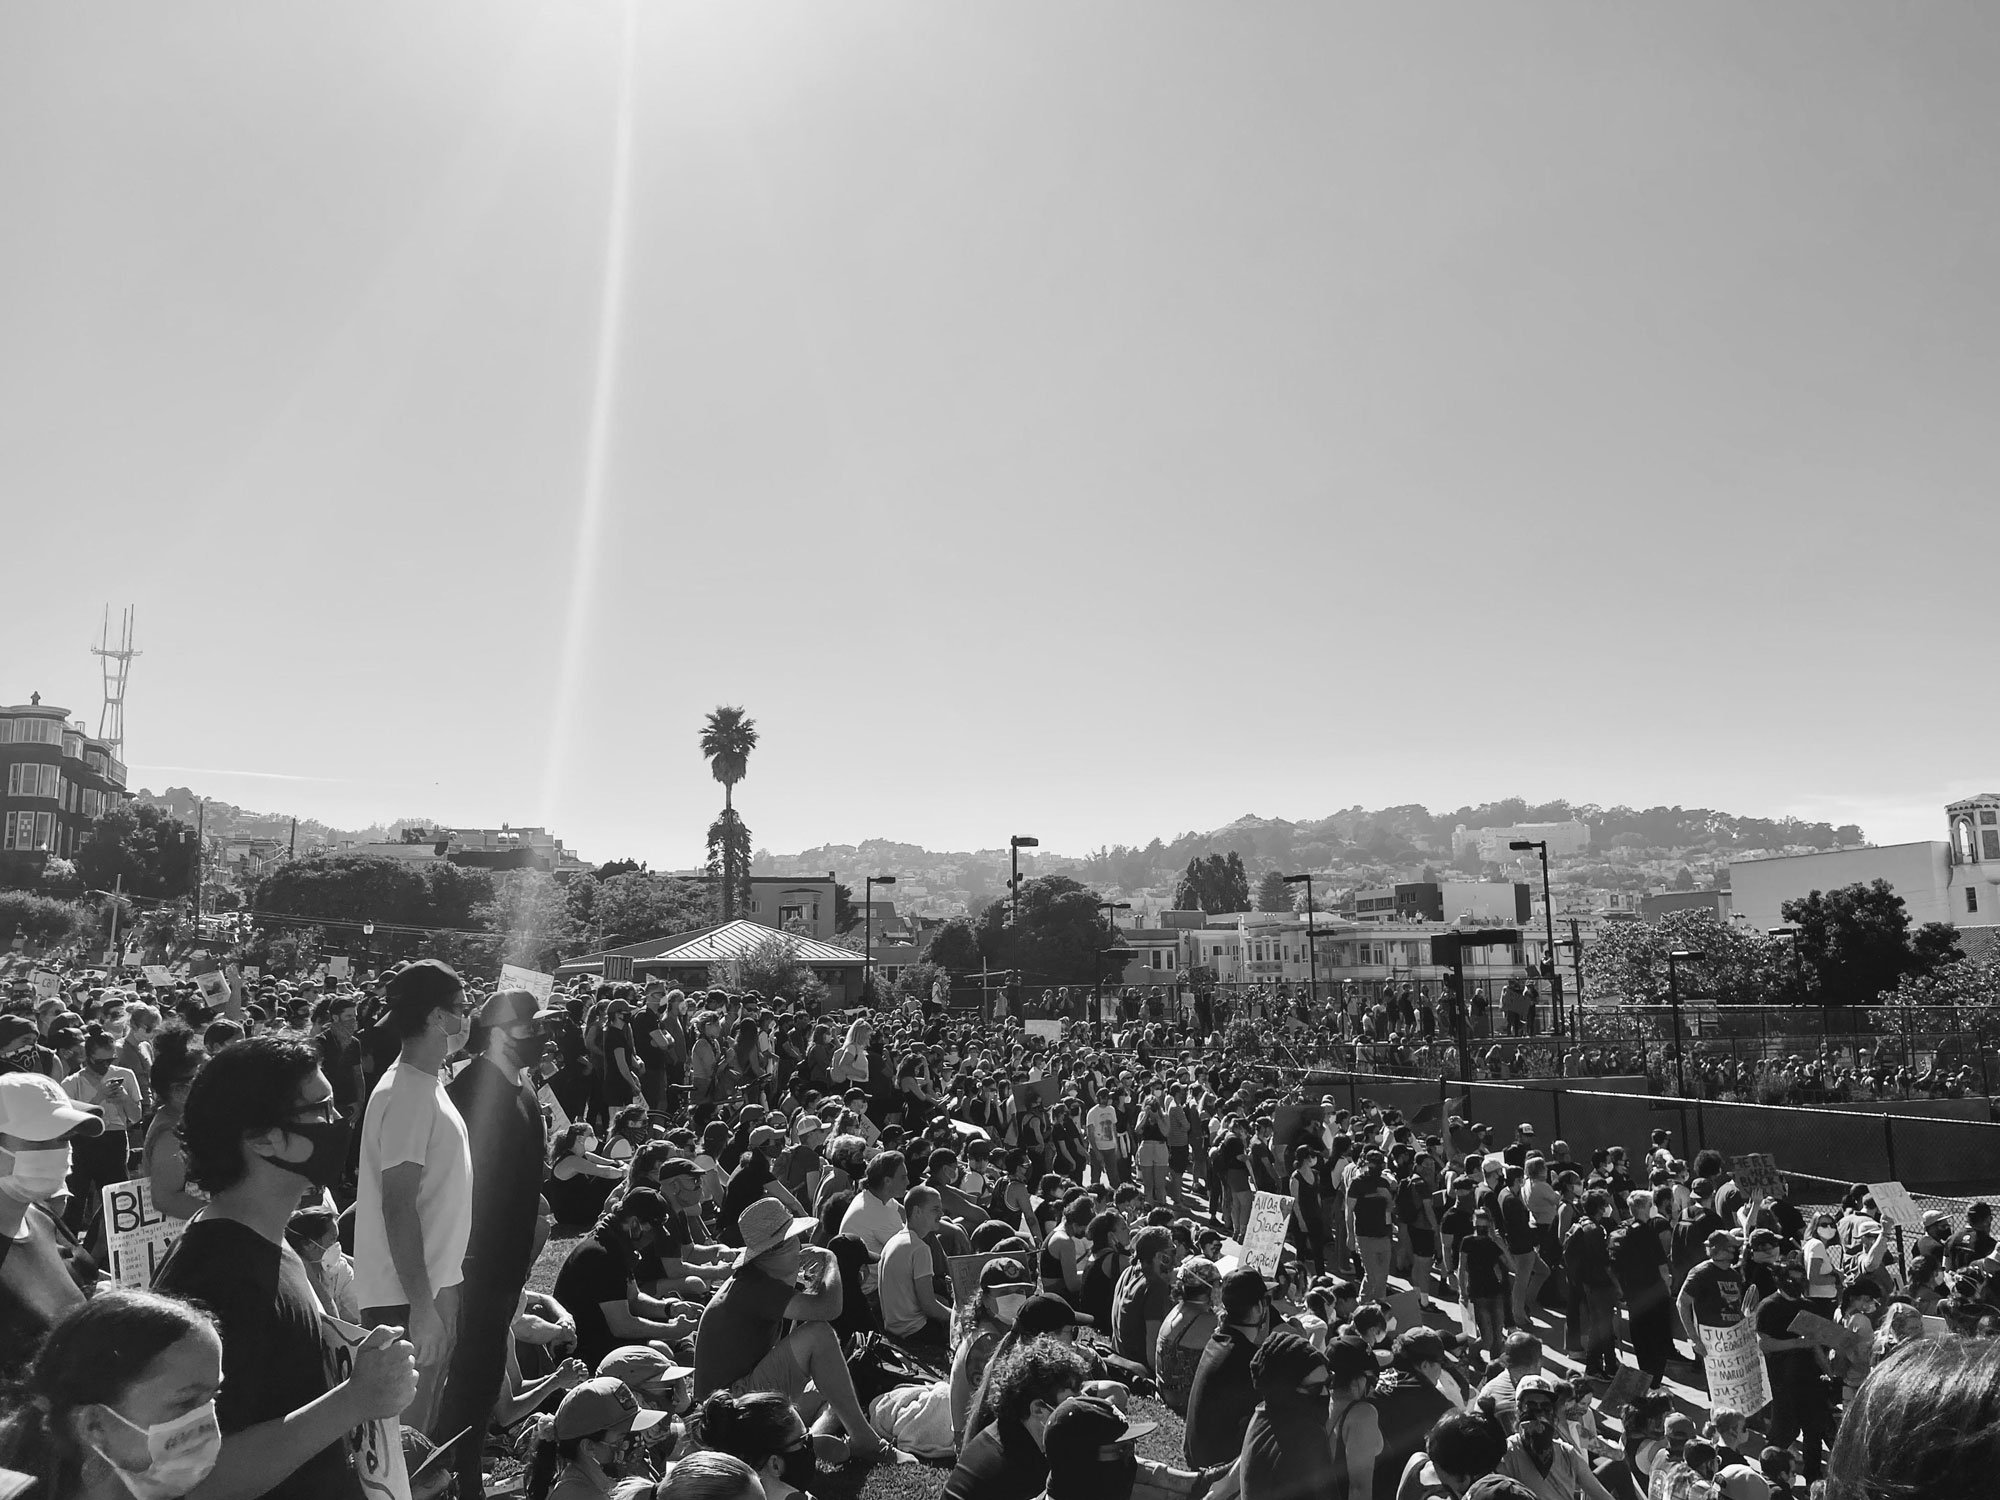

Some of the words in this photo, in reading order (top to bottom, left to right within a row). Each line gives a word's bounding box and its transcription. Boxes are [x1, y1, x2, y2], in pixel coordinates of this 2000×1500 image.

[605, 956, 633, 980] VOTE!
[1704, 1315, 1757, 1341] JUSTICE
[1708, 1350, 1758, 1369] JUSTICE
[1720, 1367, 1744, 1380] MARIO
